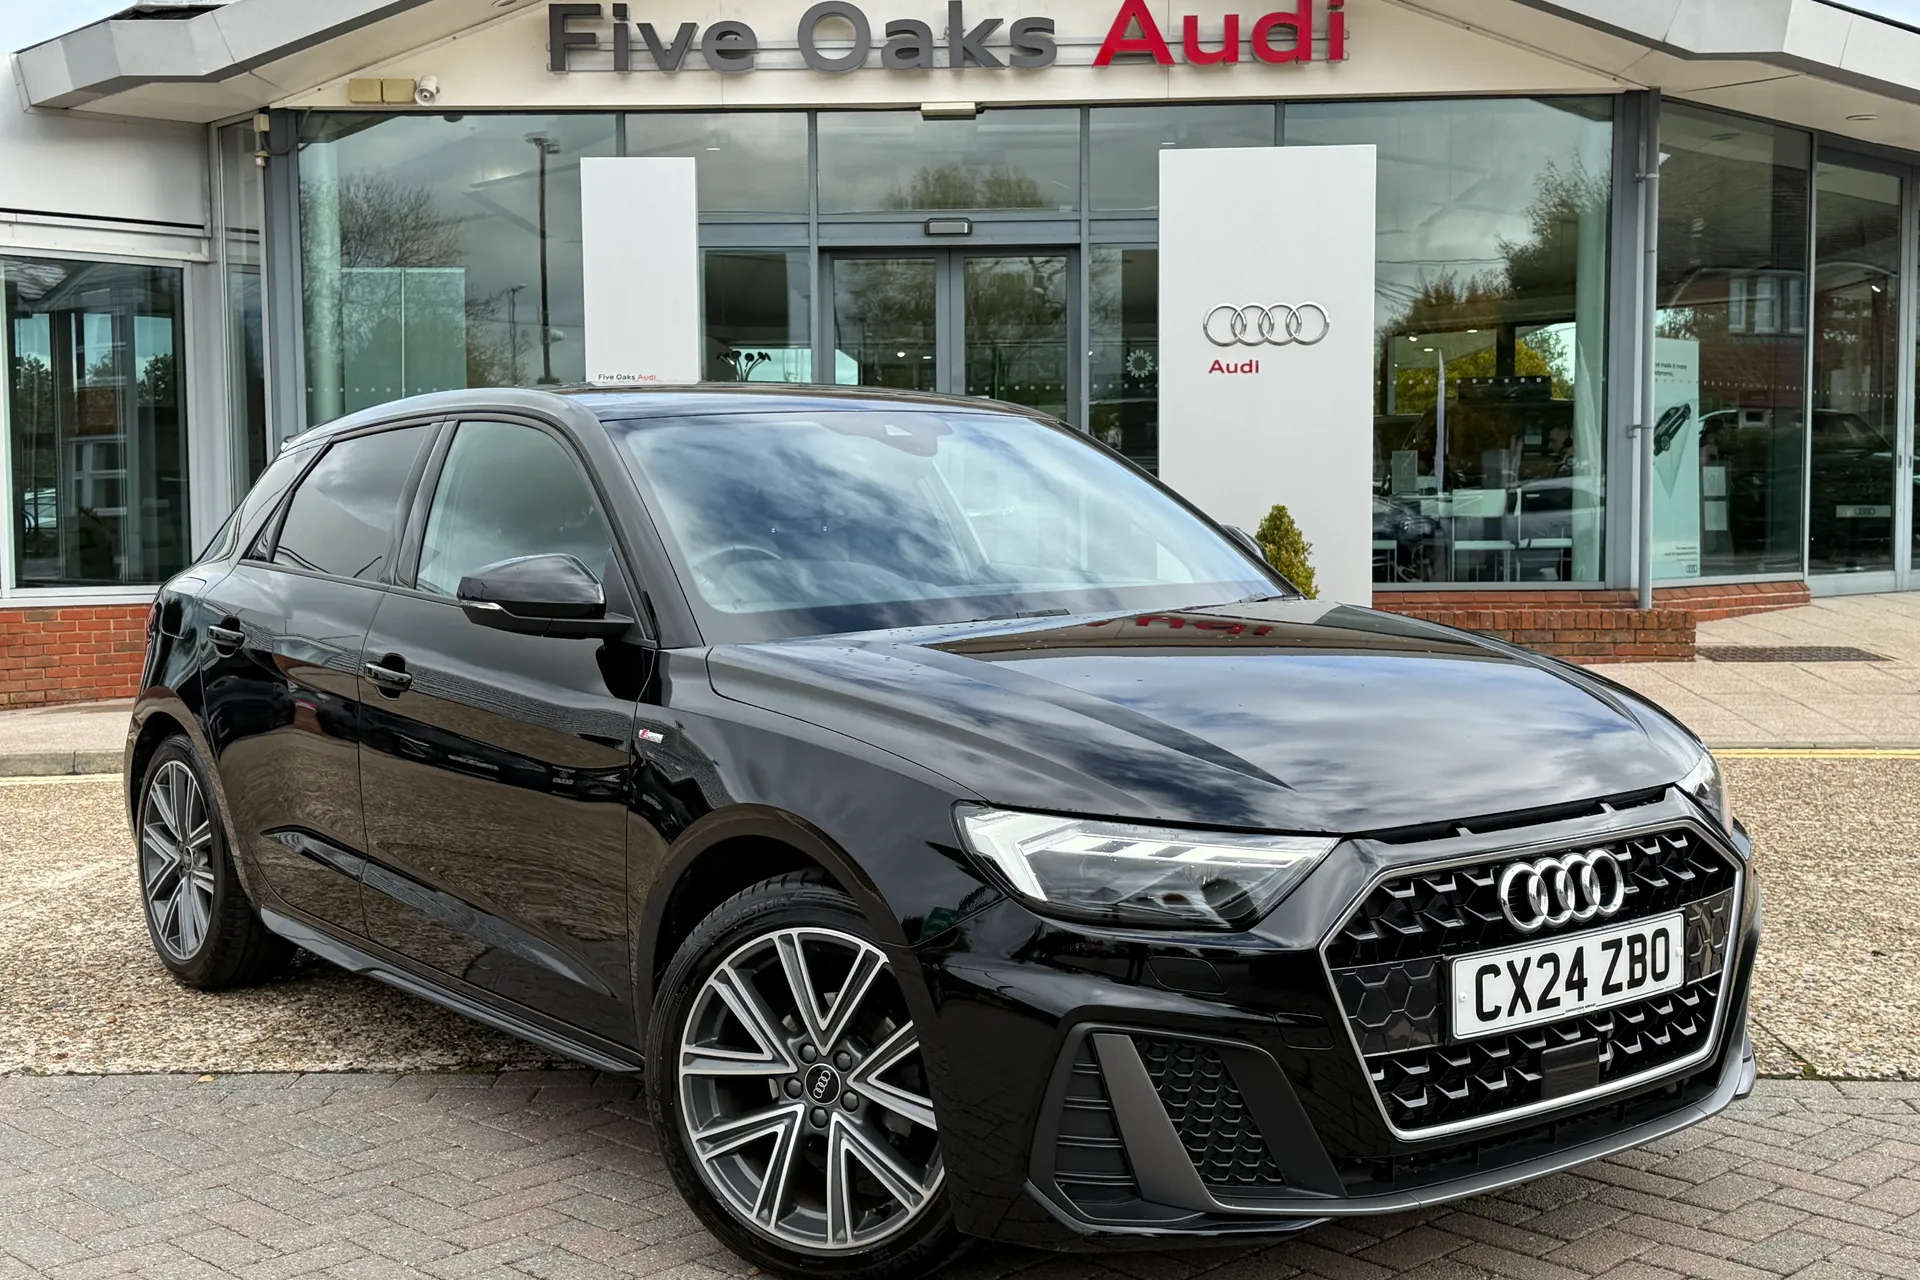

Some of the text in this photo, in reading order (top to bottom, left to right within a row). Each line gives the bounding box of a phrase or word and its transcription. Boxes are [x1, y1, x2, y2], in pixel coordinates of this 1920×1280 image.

[548, 0, 1346, 75] Five Oaks Audi
[1208, 359, 1259, 374] Audi
[1475, 927, 1671, 1023] CX24 ZBO
